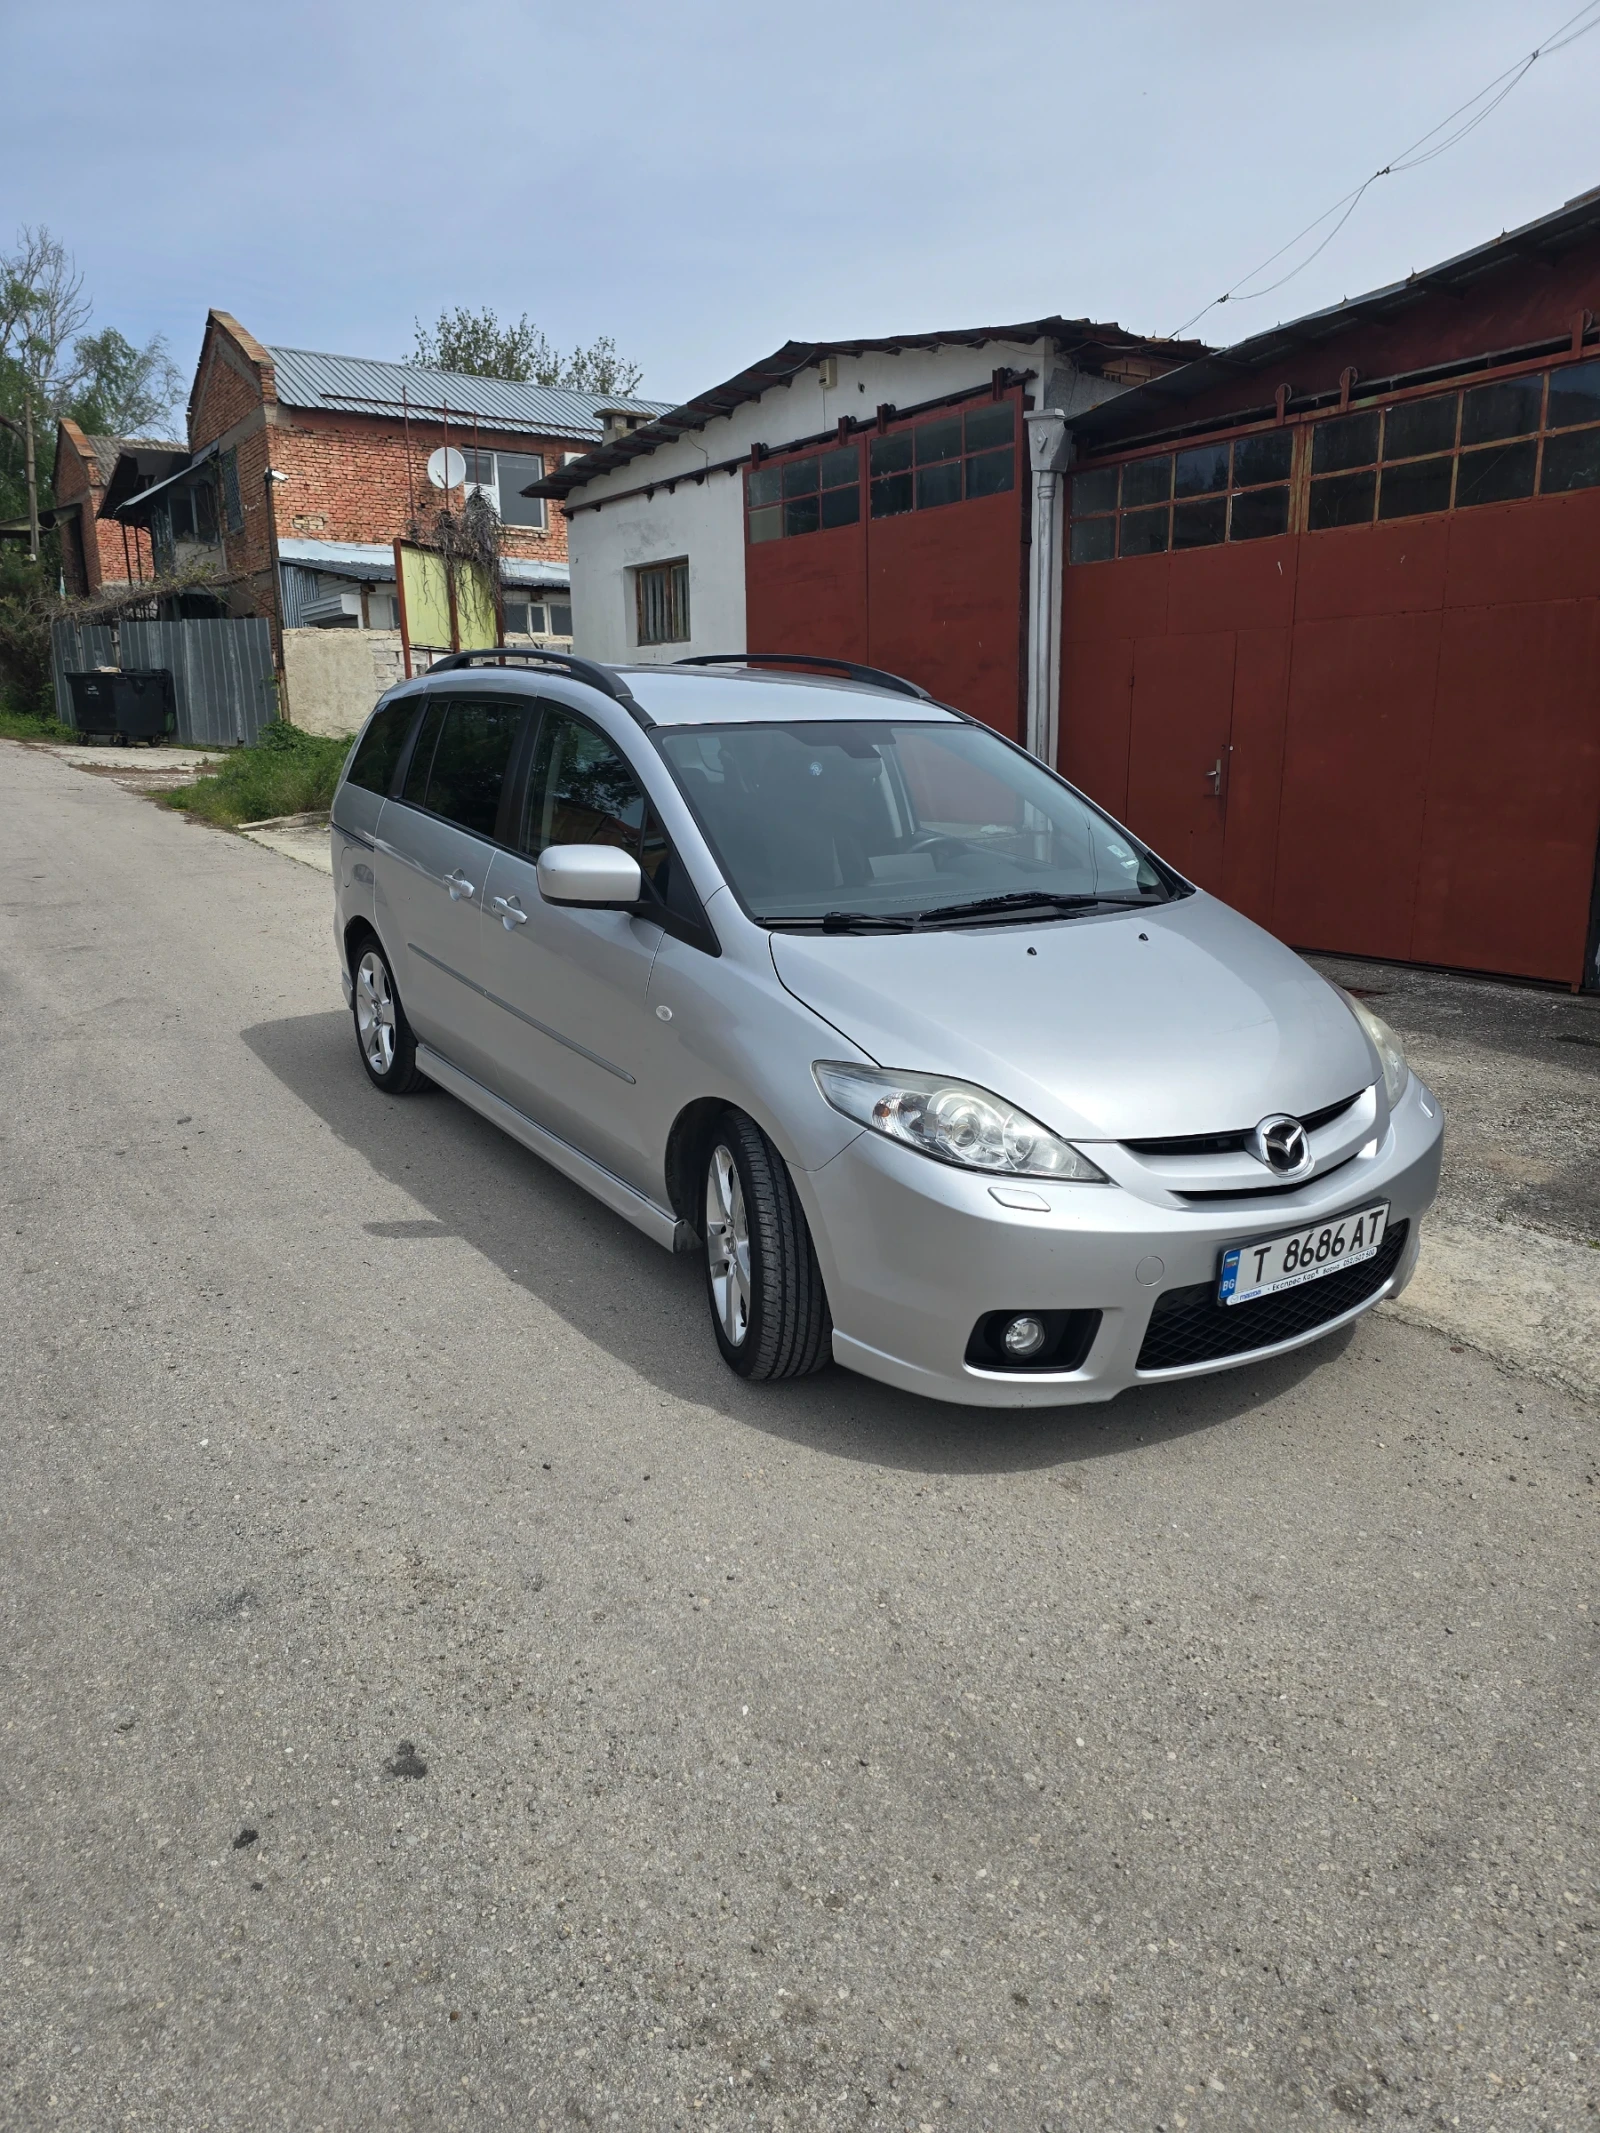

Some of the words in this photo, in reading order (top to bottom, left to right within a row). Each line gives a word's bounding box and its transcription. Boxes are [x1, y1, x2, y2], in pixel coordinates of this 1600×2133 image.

[1254, 1246, 1272, 1283] T
[1283, 1223, 1346, 1273] 8686
[1349, 1209, 1384, 1252] AT
[1222, 1279, 1235, 1292] BG
